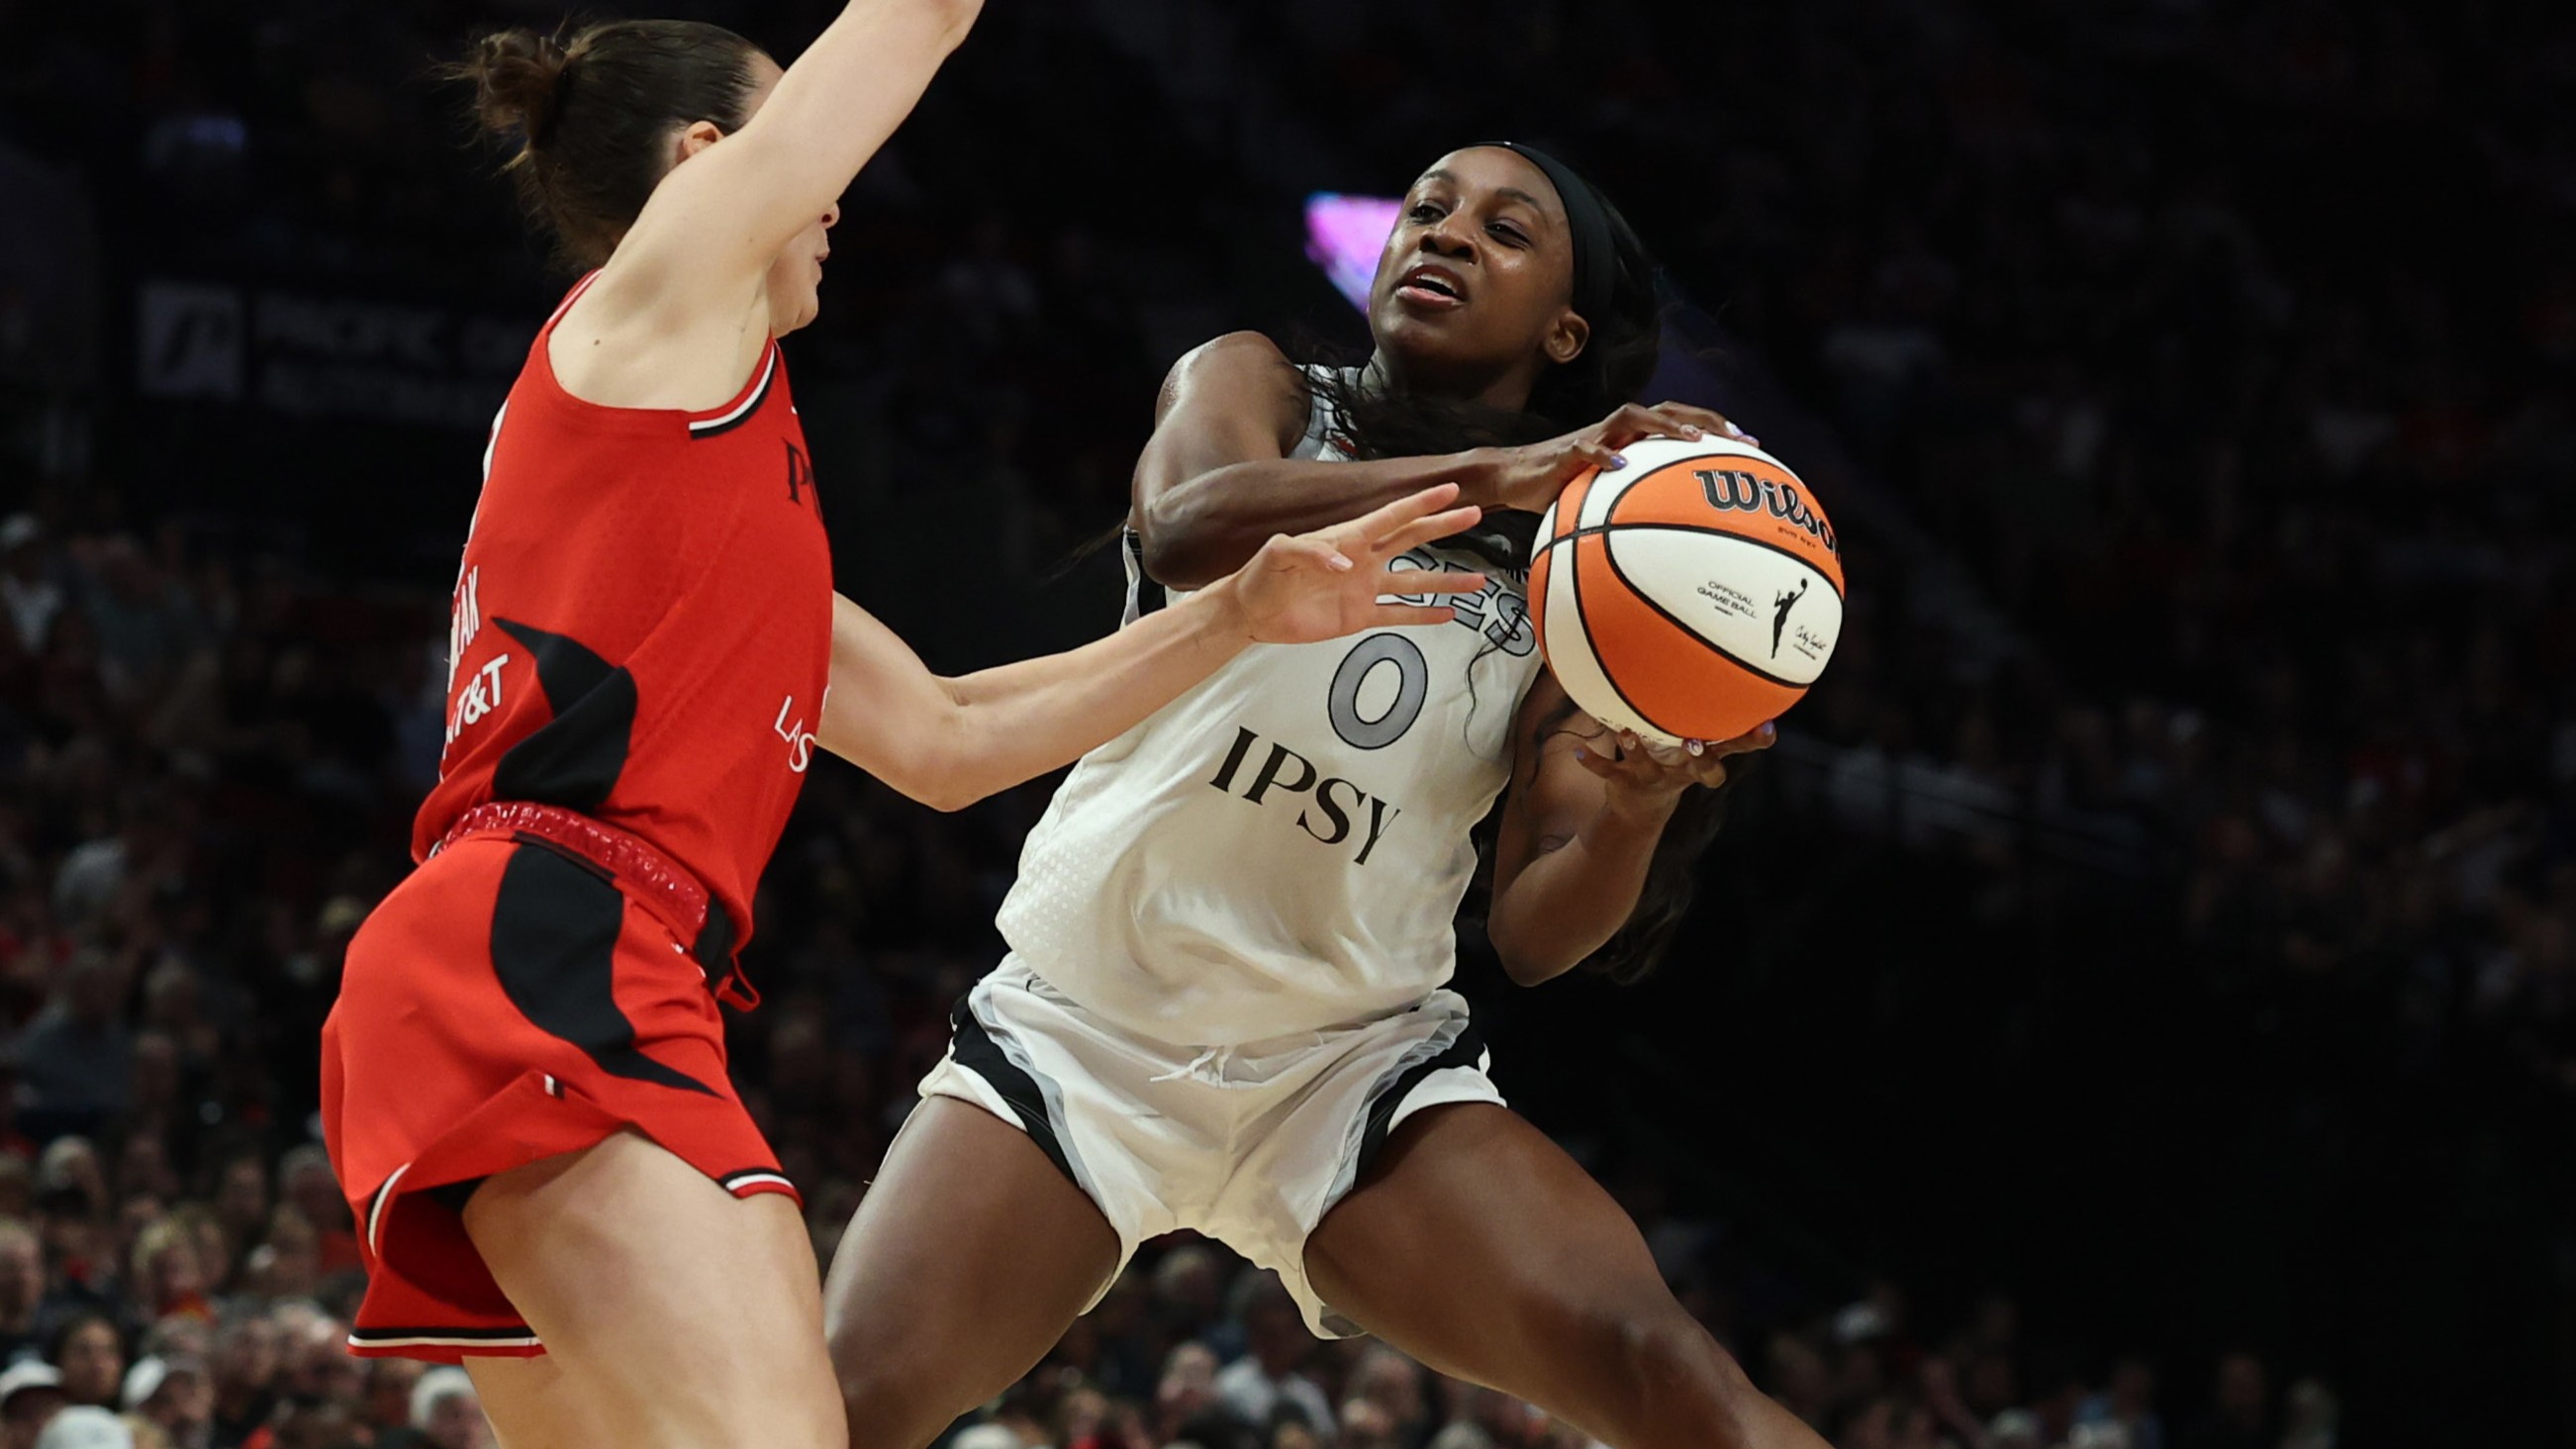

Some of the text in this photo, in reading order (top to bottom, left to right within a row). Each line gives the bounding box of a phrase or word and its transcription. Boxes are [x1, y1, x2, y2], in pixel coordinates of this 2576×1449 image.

[1692, 469, 1841, 564] Wilso
[1388, 547, 1536, 656] CES
[1697, 586, 1730, 606] GAME
[1730, 601, 1757, 619] BALL
[1708, 581, 1755, 607] OFFICIAL
[1327, 632, 1428, 750] 0
[1209, 725, 1401, 866] IPSY
